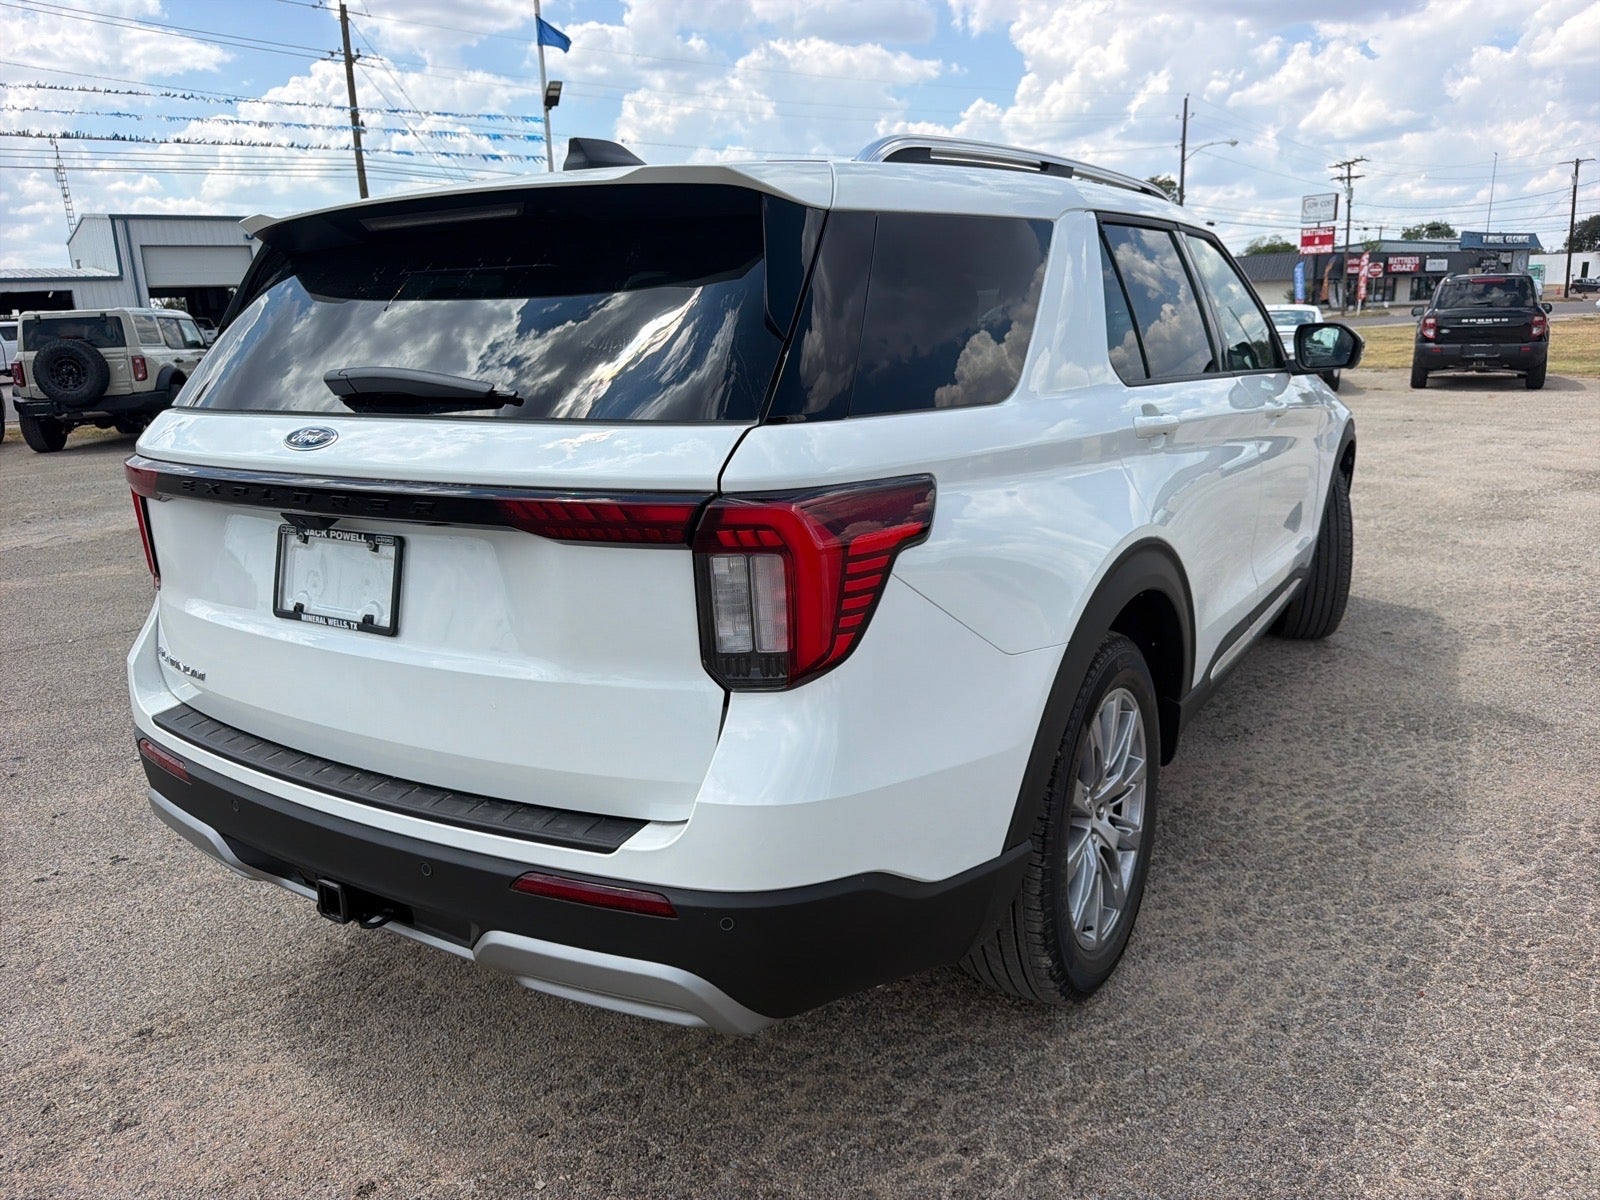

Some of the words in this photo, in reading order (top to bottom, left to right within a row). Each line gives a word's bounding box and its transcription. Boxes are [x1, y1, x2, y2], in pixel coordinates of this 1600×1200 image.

[1388, 256, 1419, 264] MATTRESS
[1391, 264, 1416, 272] CRAZY
[181, 480, 437, 515] EXPLORER
[304, 528, 328, 538] JACK
[329, 530, 367, 542] POWELL
[301, 613, 327, 625] MINERAL
[327, 617, 350, 630] WELLS,
[350, 622, 358, 630] TX
